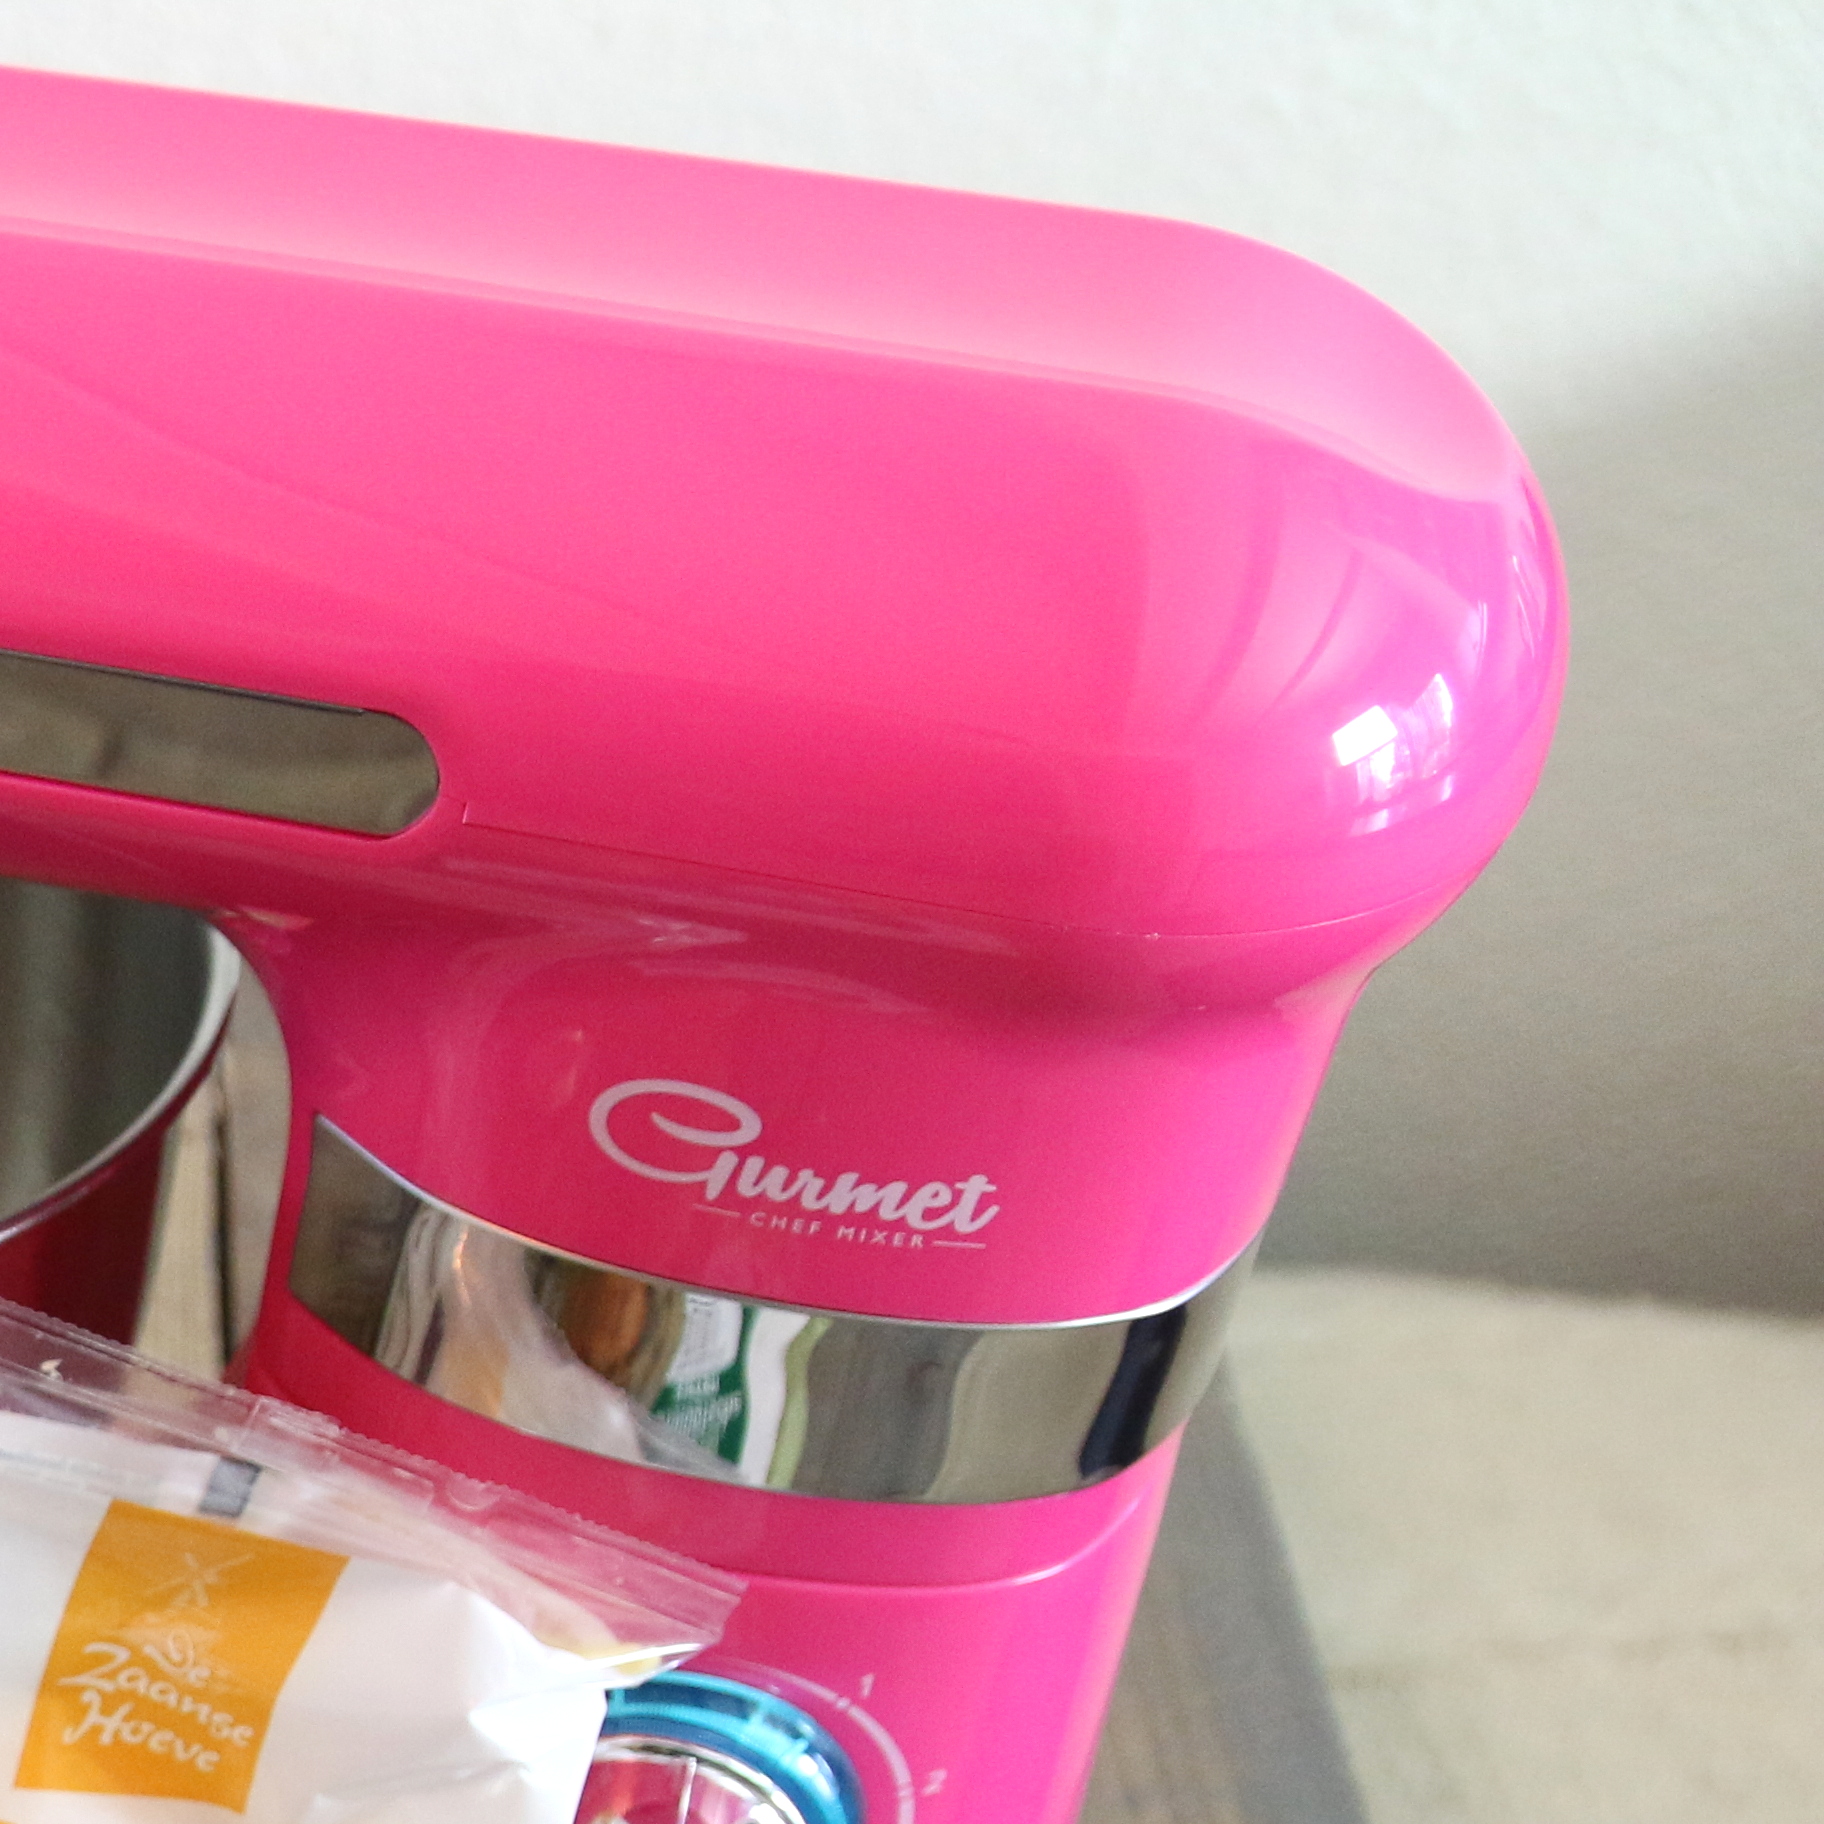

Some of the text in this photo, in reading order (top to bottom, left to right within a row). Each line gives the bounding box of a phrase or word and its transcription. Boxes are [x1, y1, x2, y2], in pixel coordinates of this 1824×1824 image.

[588, 1078, 1000, 1234] Gurmet
[749, 1211, 925, 1250] CHEF MIXER
[56, 1641, 255, 1748] Zaanse
[62, 1689, 221, 1773] Hoeve
